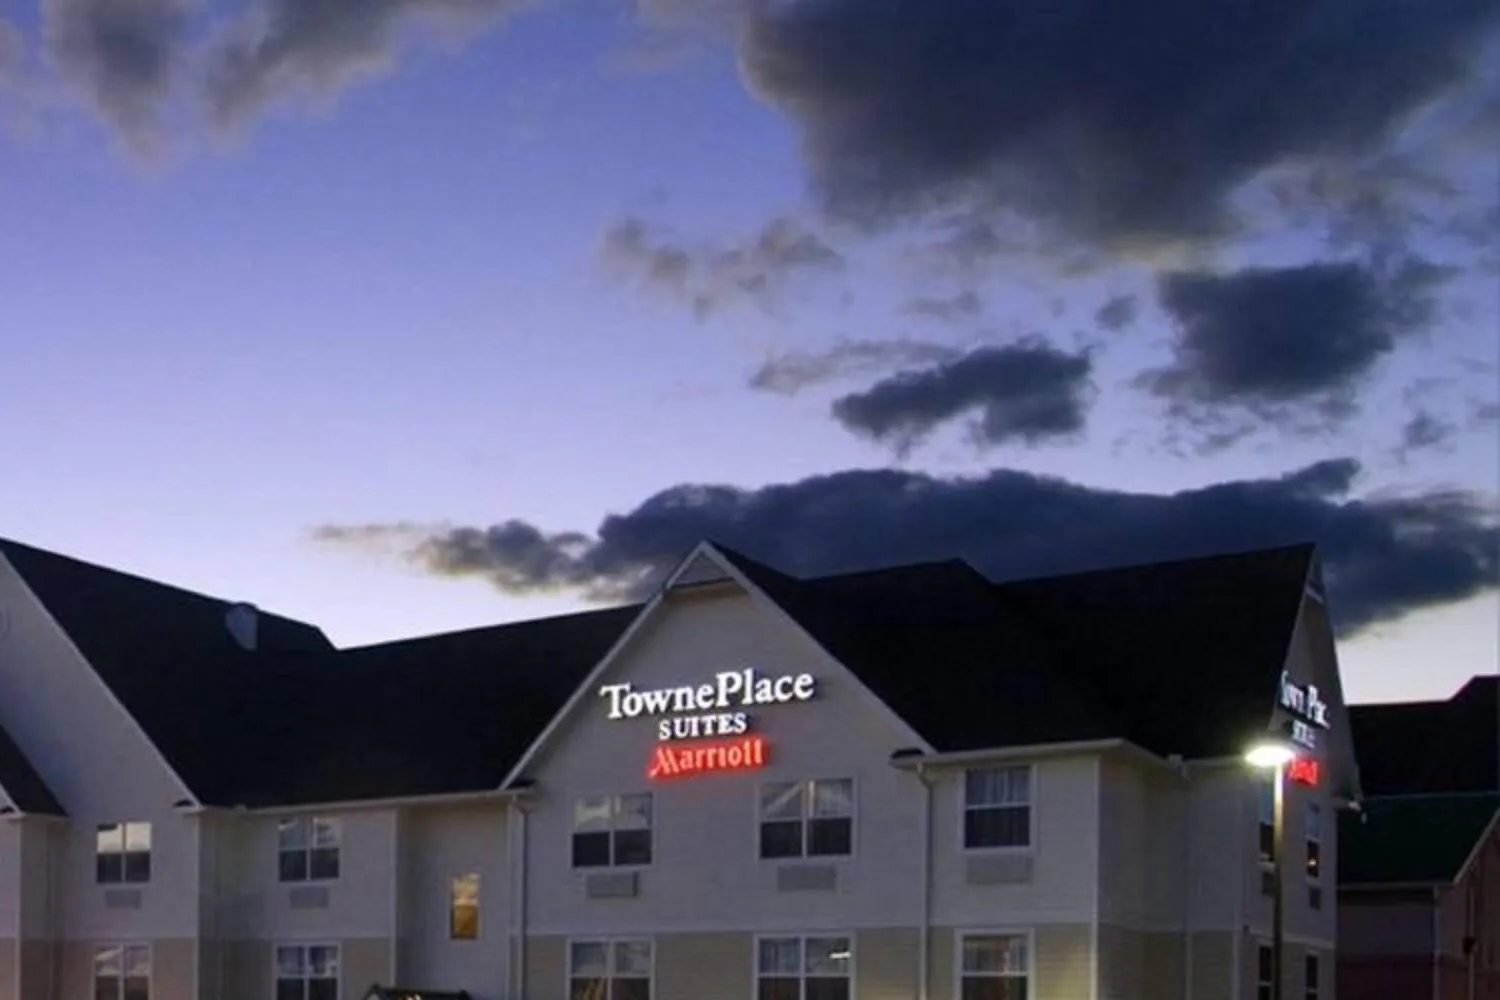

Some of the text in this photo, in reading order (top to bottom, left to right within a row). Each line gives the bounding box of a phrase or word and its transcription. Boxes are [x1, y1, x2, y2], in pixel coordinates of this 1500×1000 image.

[599, 667, 814, 719] TownePlace
[658, 712, 748, 741] SUITES
[647, 737, 764, 779] Marriott
